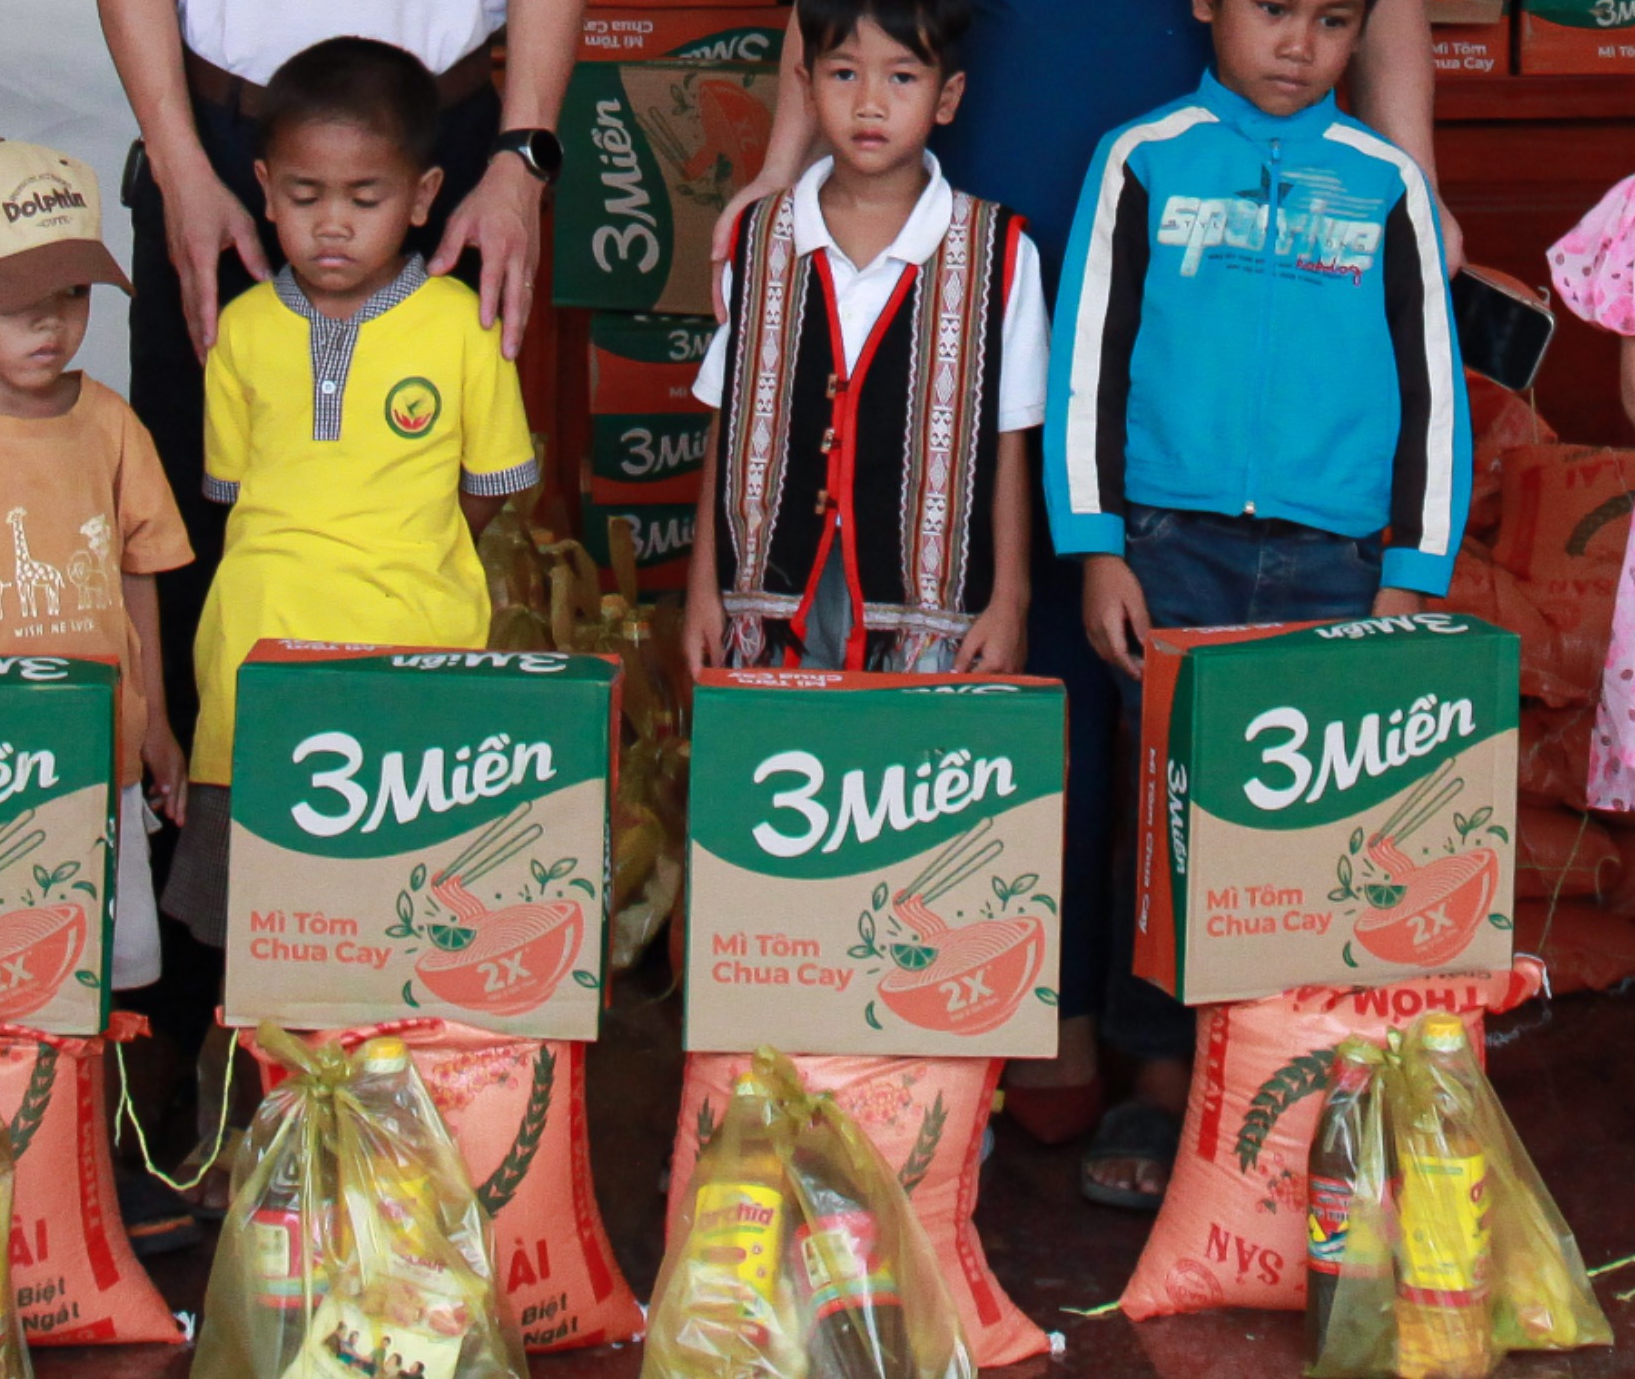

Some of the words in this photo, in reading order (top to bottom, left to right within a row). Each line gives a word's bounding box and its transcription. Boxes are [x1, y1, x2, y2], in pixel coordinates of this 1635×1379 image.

[612, 21, 654, 32] Chua
[1465, 56, 1494, 72] Cay
[2, 188, 86, 222] Dolphin
[1243, 693, 1479, 815] 3Miền
[291, 731, 560, 840] 3Miền
[752, 749, 1020, 861] 3Miền
[1207, 886, 1238, 911] Mì
[1245, 884, 1303, 908] Tôm
[251, 911, 285, 940] Mì
[293, 911, 358, 936] Tôm
[1207, 914, 1277, 937] Chua
[1283, 910, 1332, 935] Cay
[1402, 912, 1453, 950] 2X
[250, 938, 328, 962] Chua
[335, 941, 392, 970] Cay
[713, 933, 747, 956] Mì
[755, 933, 820, 957] Tôm
[472, 954, 534, 992] 2X
[712, 961, 790, 984] Chua
[797, 963, 854, 992] Cay
[935, 974, 995, 1017] 2X
